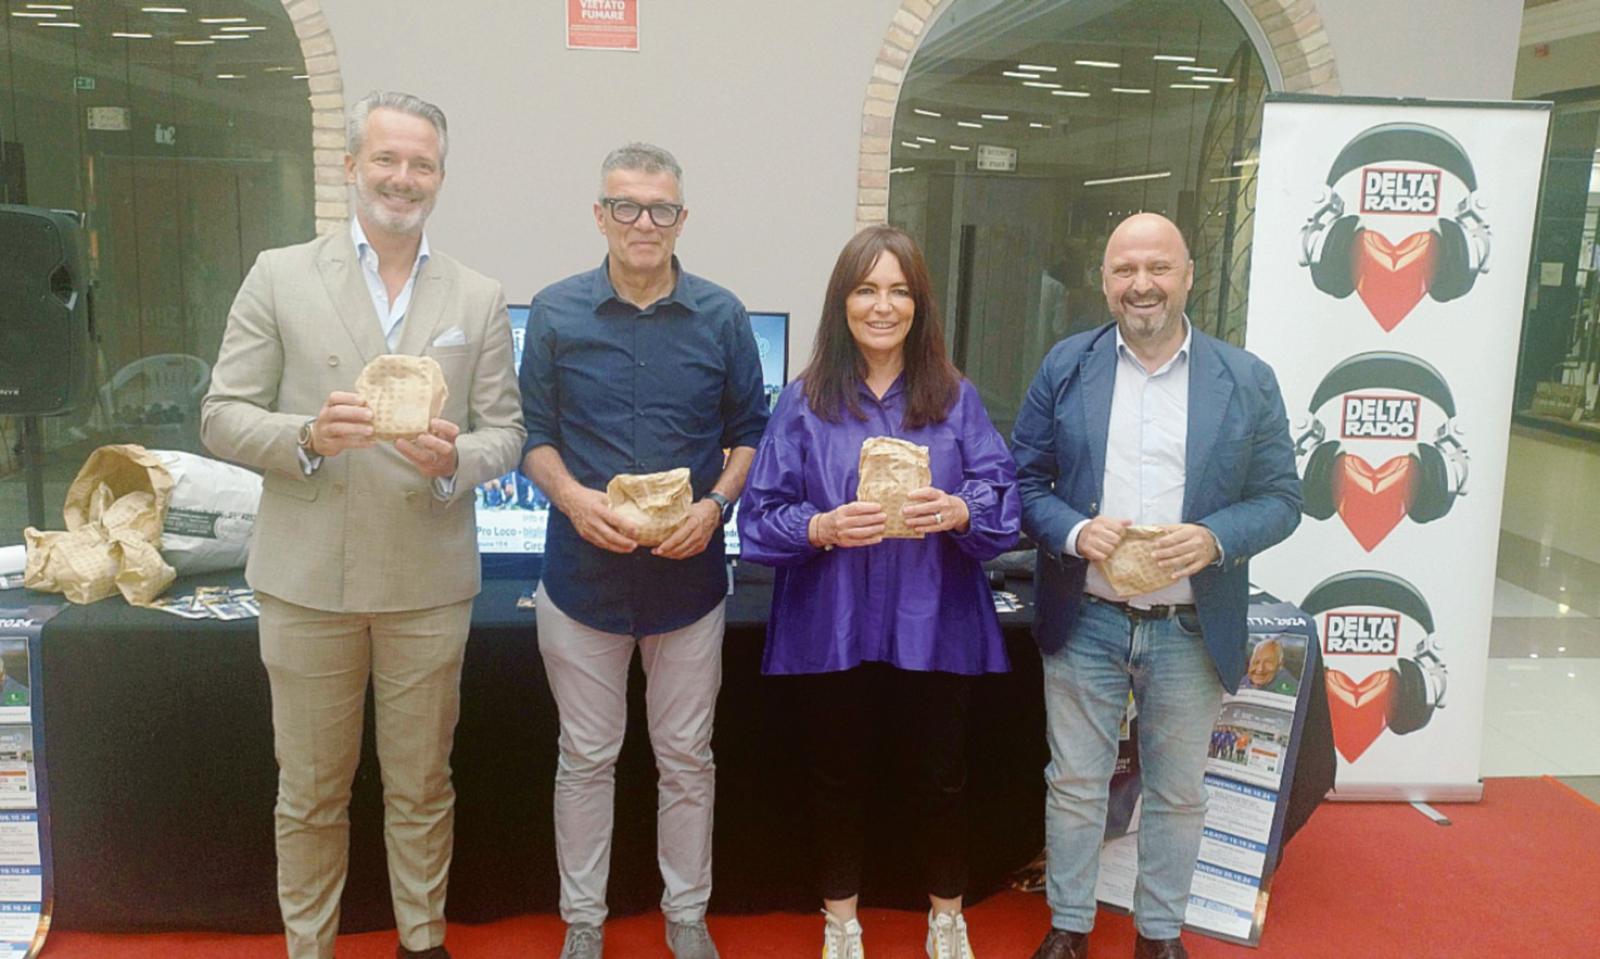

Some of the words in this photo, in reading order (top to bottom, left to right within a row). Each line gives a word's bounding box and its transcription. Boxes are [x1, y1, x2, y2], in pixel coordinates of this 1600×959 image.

[579, 0, 625, 10] VIETATO
[582, 10, 625, 20] FUMARE
[1365, 172, 1437, 196] DELTA
[1364, 196, 1436, 212] RADIO
[1346, 399, 1417, 421] DELTA
[1345, 421, 1415, 437] RADIO
[494, 526, 517, 536] Loco
[1247, 617, 1274, 626] TTA
[1329, 616, 1397, 638] DELTA
[1327, 638, 1395, 653] RADIO
